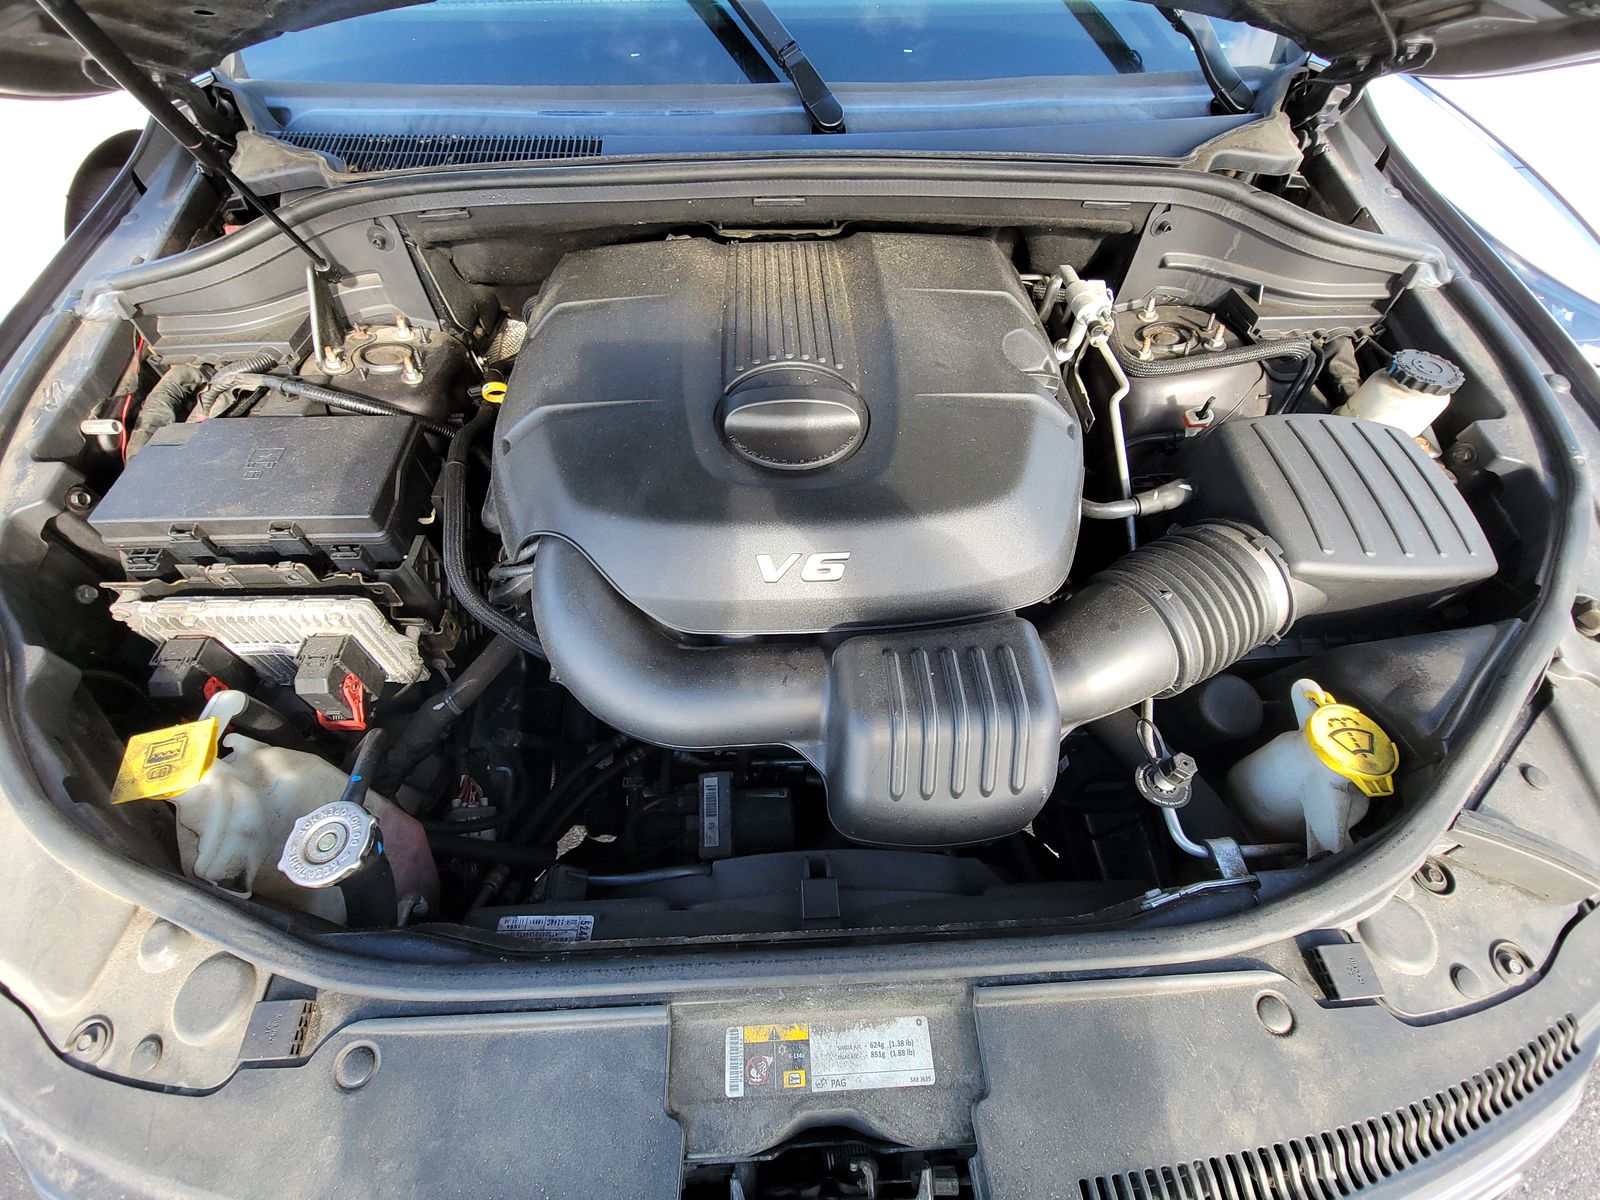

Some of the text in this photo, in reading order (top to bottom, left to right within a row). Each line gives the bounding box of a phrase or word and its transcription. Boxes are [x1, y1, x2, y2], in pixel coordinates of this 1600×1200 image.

[755, 551, 851, 584] V6
[869, 1041, 885, 1050] 624g
[889, 1040, 905, 1049] (1.38
[905, 1038, 914, 1048] lb)
[870, 1050, 886, 1059] 851g
[890, 1049, 906, 1058] (1.88
[906, 1048, 916, 1057] lb)
[831, 1079, 847, 1088] PAG
